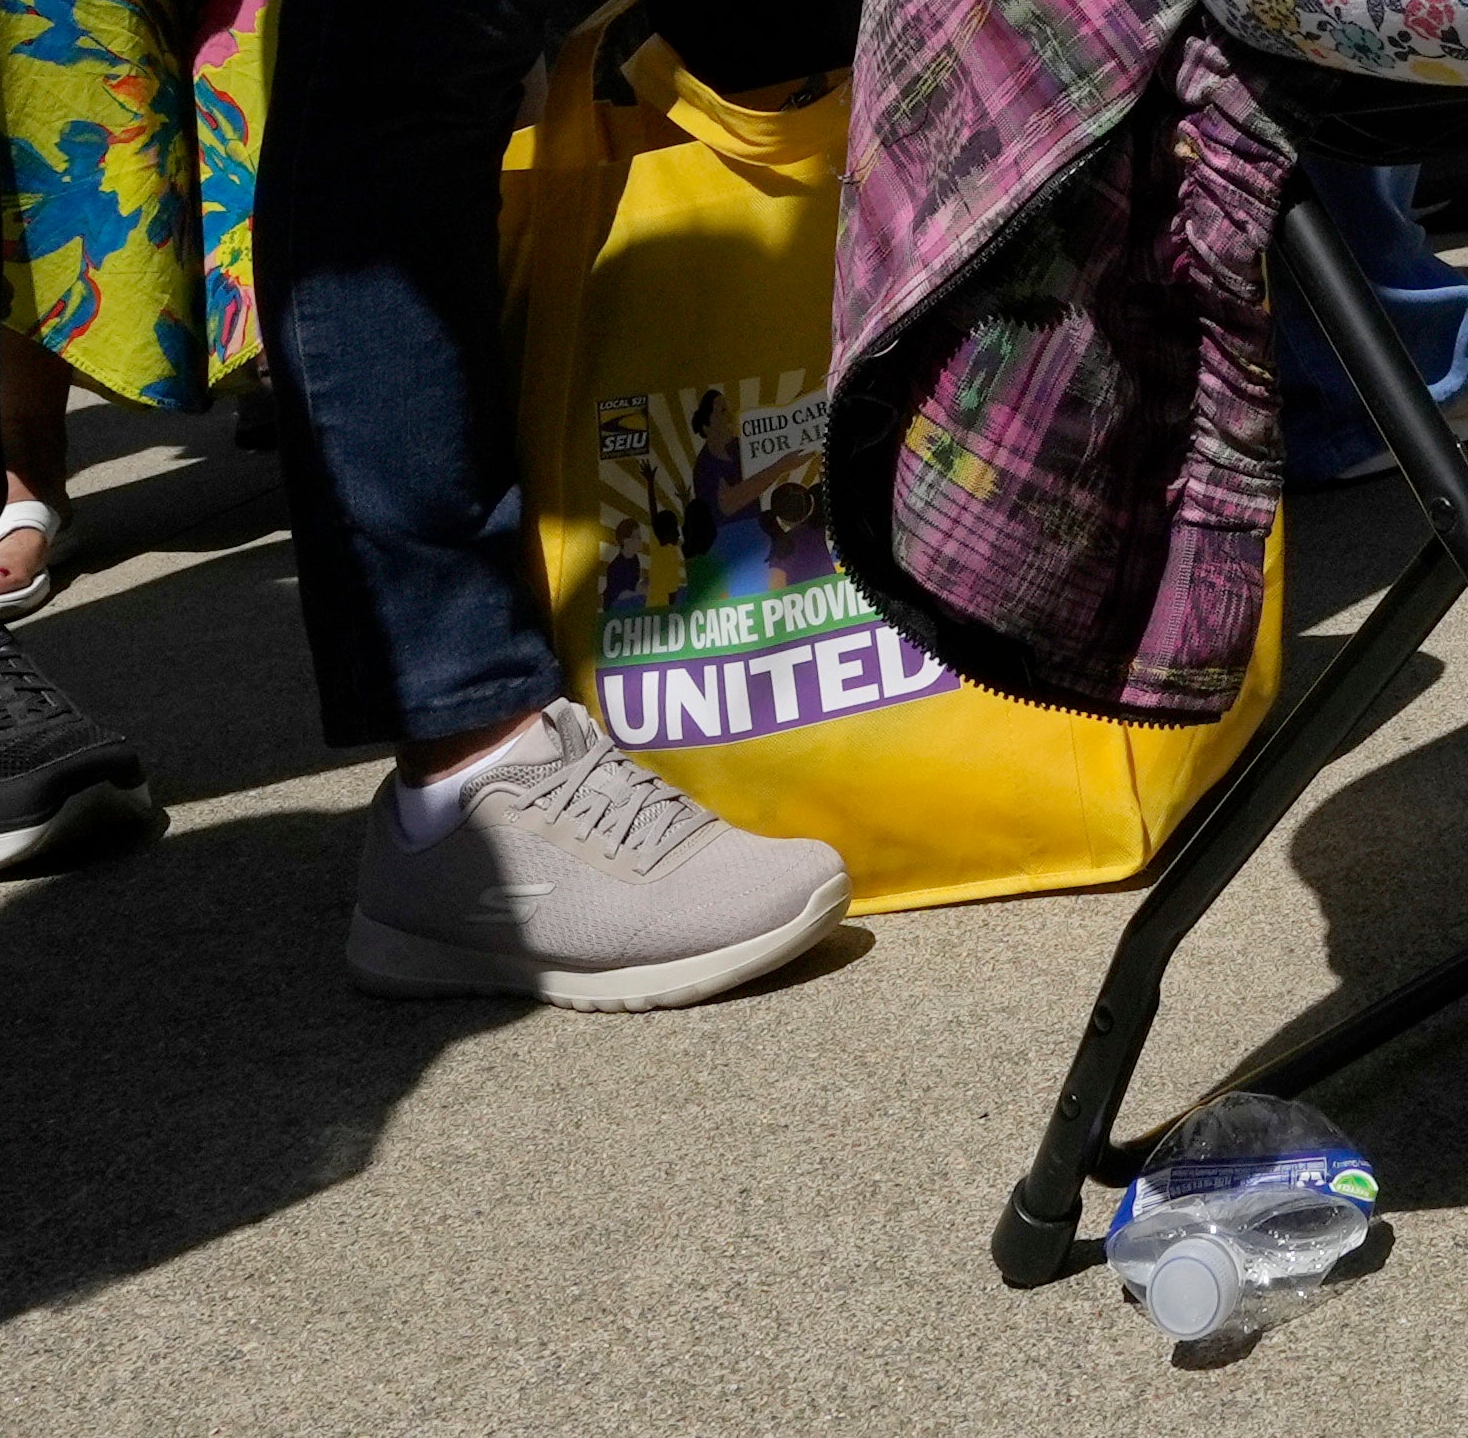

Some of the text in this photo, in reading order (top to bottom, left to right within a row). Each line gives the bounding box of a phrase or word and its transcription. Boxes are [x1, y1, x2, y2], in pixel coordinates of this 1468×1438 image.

[600, 397, 630, 411] LOCAL
[742, 400, 832, 438] CHILD CAR
[602, 430, 648, 453] SEIU
[749, 424, 828, 460] FOR AL
[602, 579, 877, 659] CHILD CARE PROVI
[602, 625, 948, 745] UNITED
